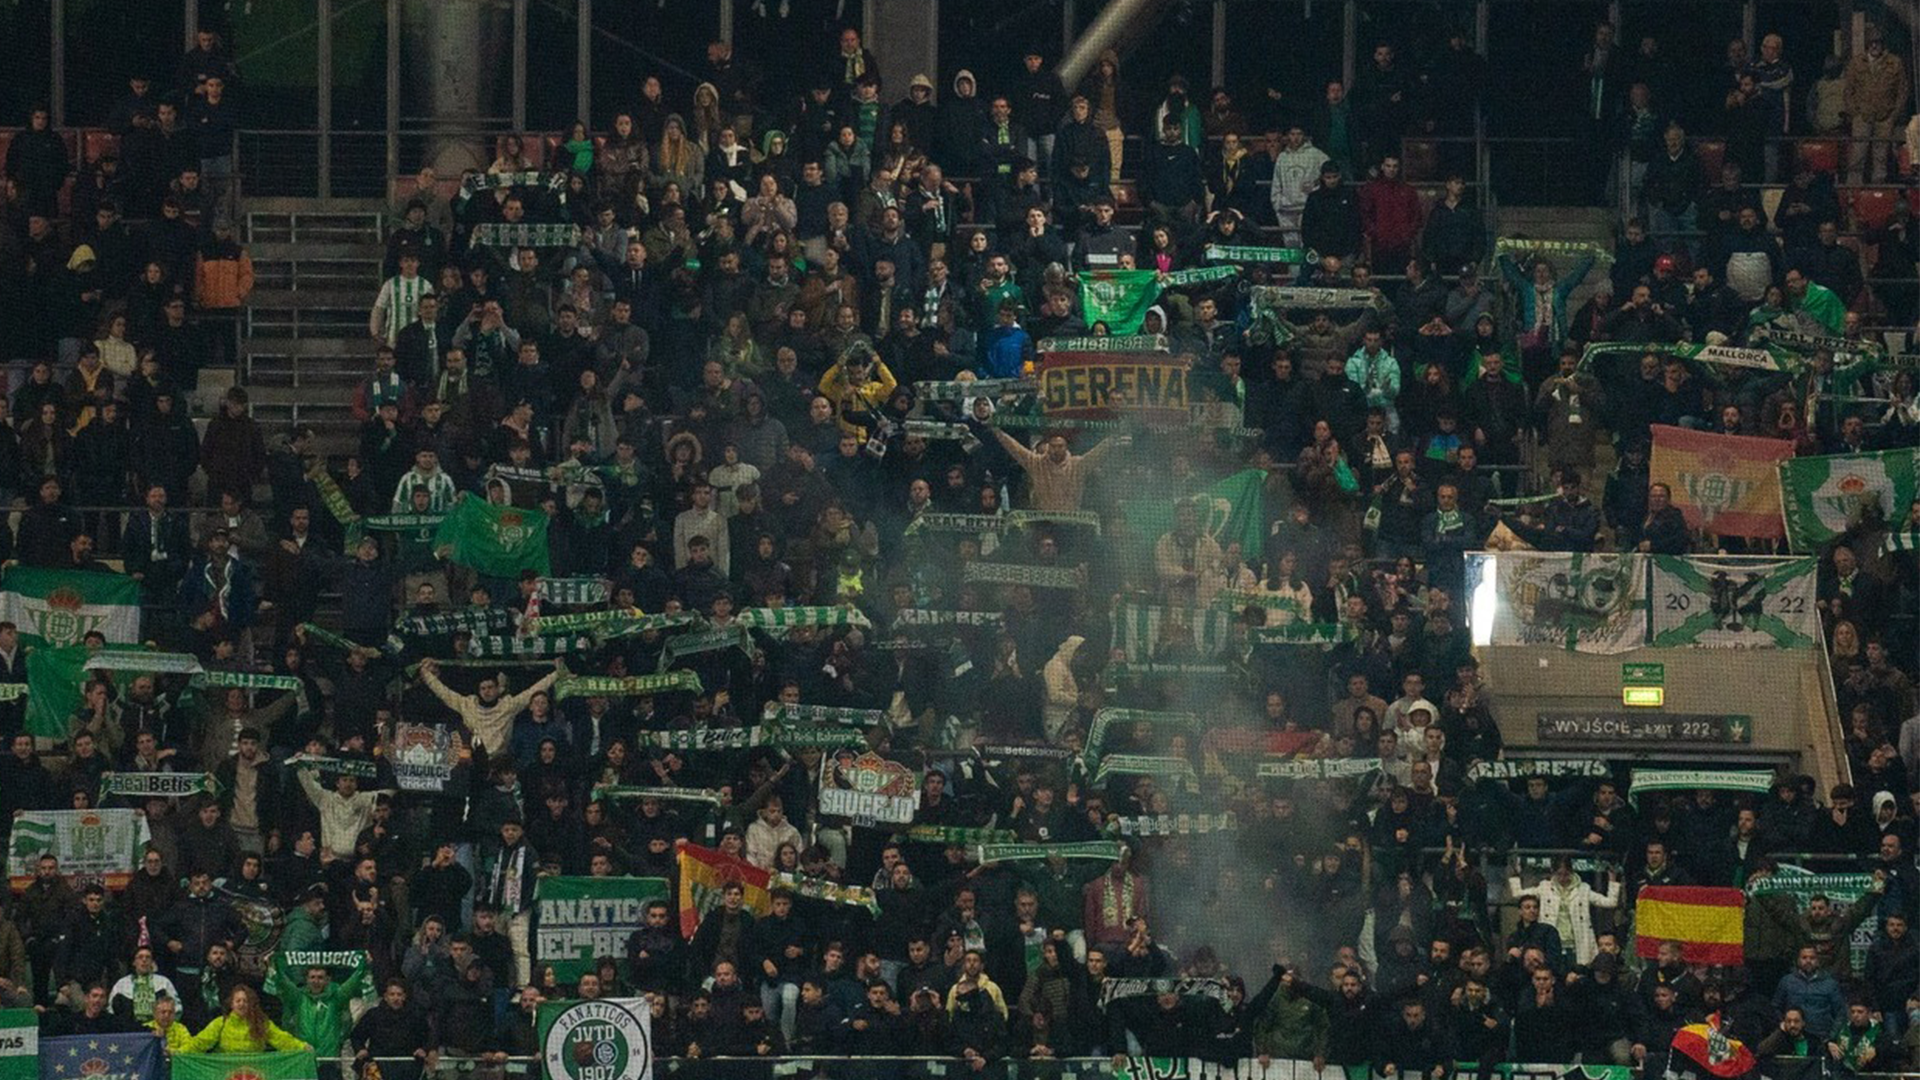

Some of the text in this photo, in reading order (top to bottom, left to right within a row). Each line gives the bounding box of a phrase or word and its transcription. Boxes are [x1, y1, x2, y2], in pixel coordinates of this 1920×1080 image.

[1708, 349, 1769, 364] MALLORCA
[1045, 367, 1184, 409] GERENA
[1666, 593, 1690, 611] 20
[1780, 596, 1805, 614] 22
[1554, 717, 1631, 736] WYJŚCIE
[1682, 722, 1710, 737] 222
[821, 789, 913, 824] SAUCEJO
[559, 1004, 632, 1030] FANATICOS
[577, 1065, 616, 1080] 1907
